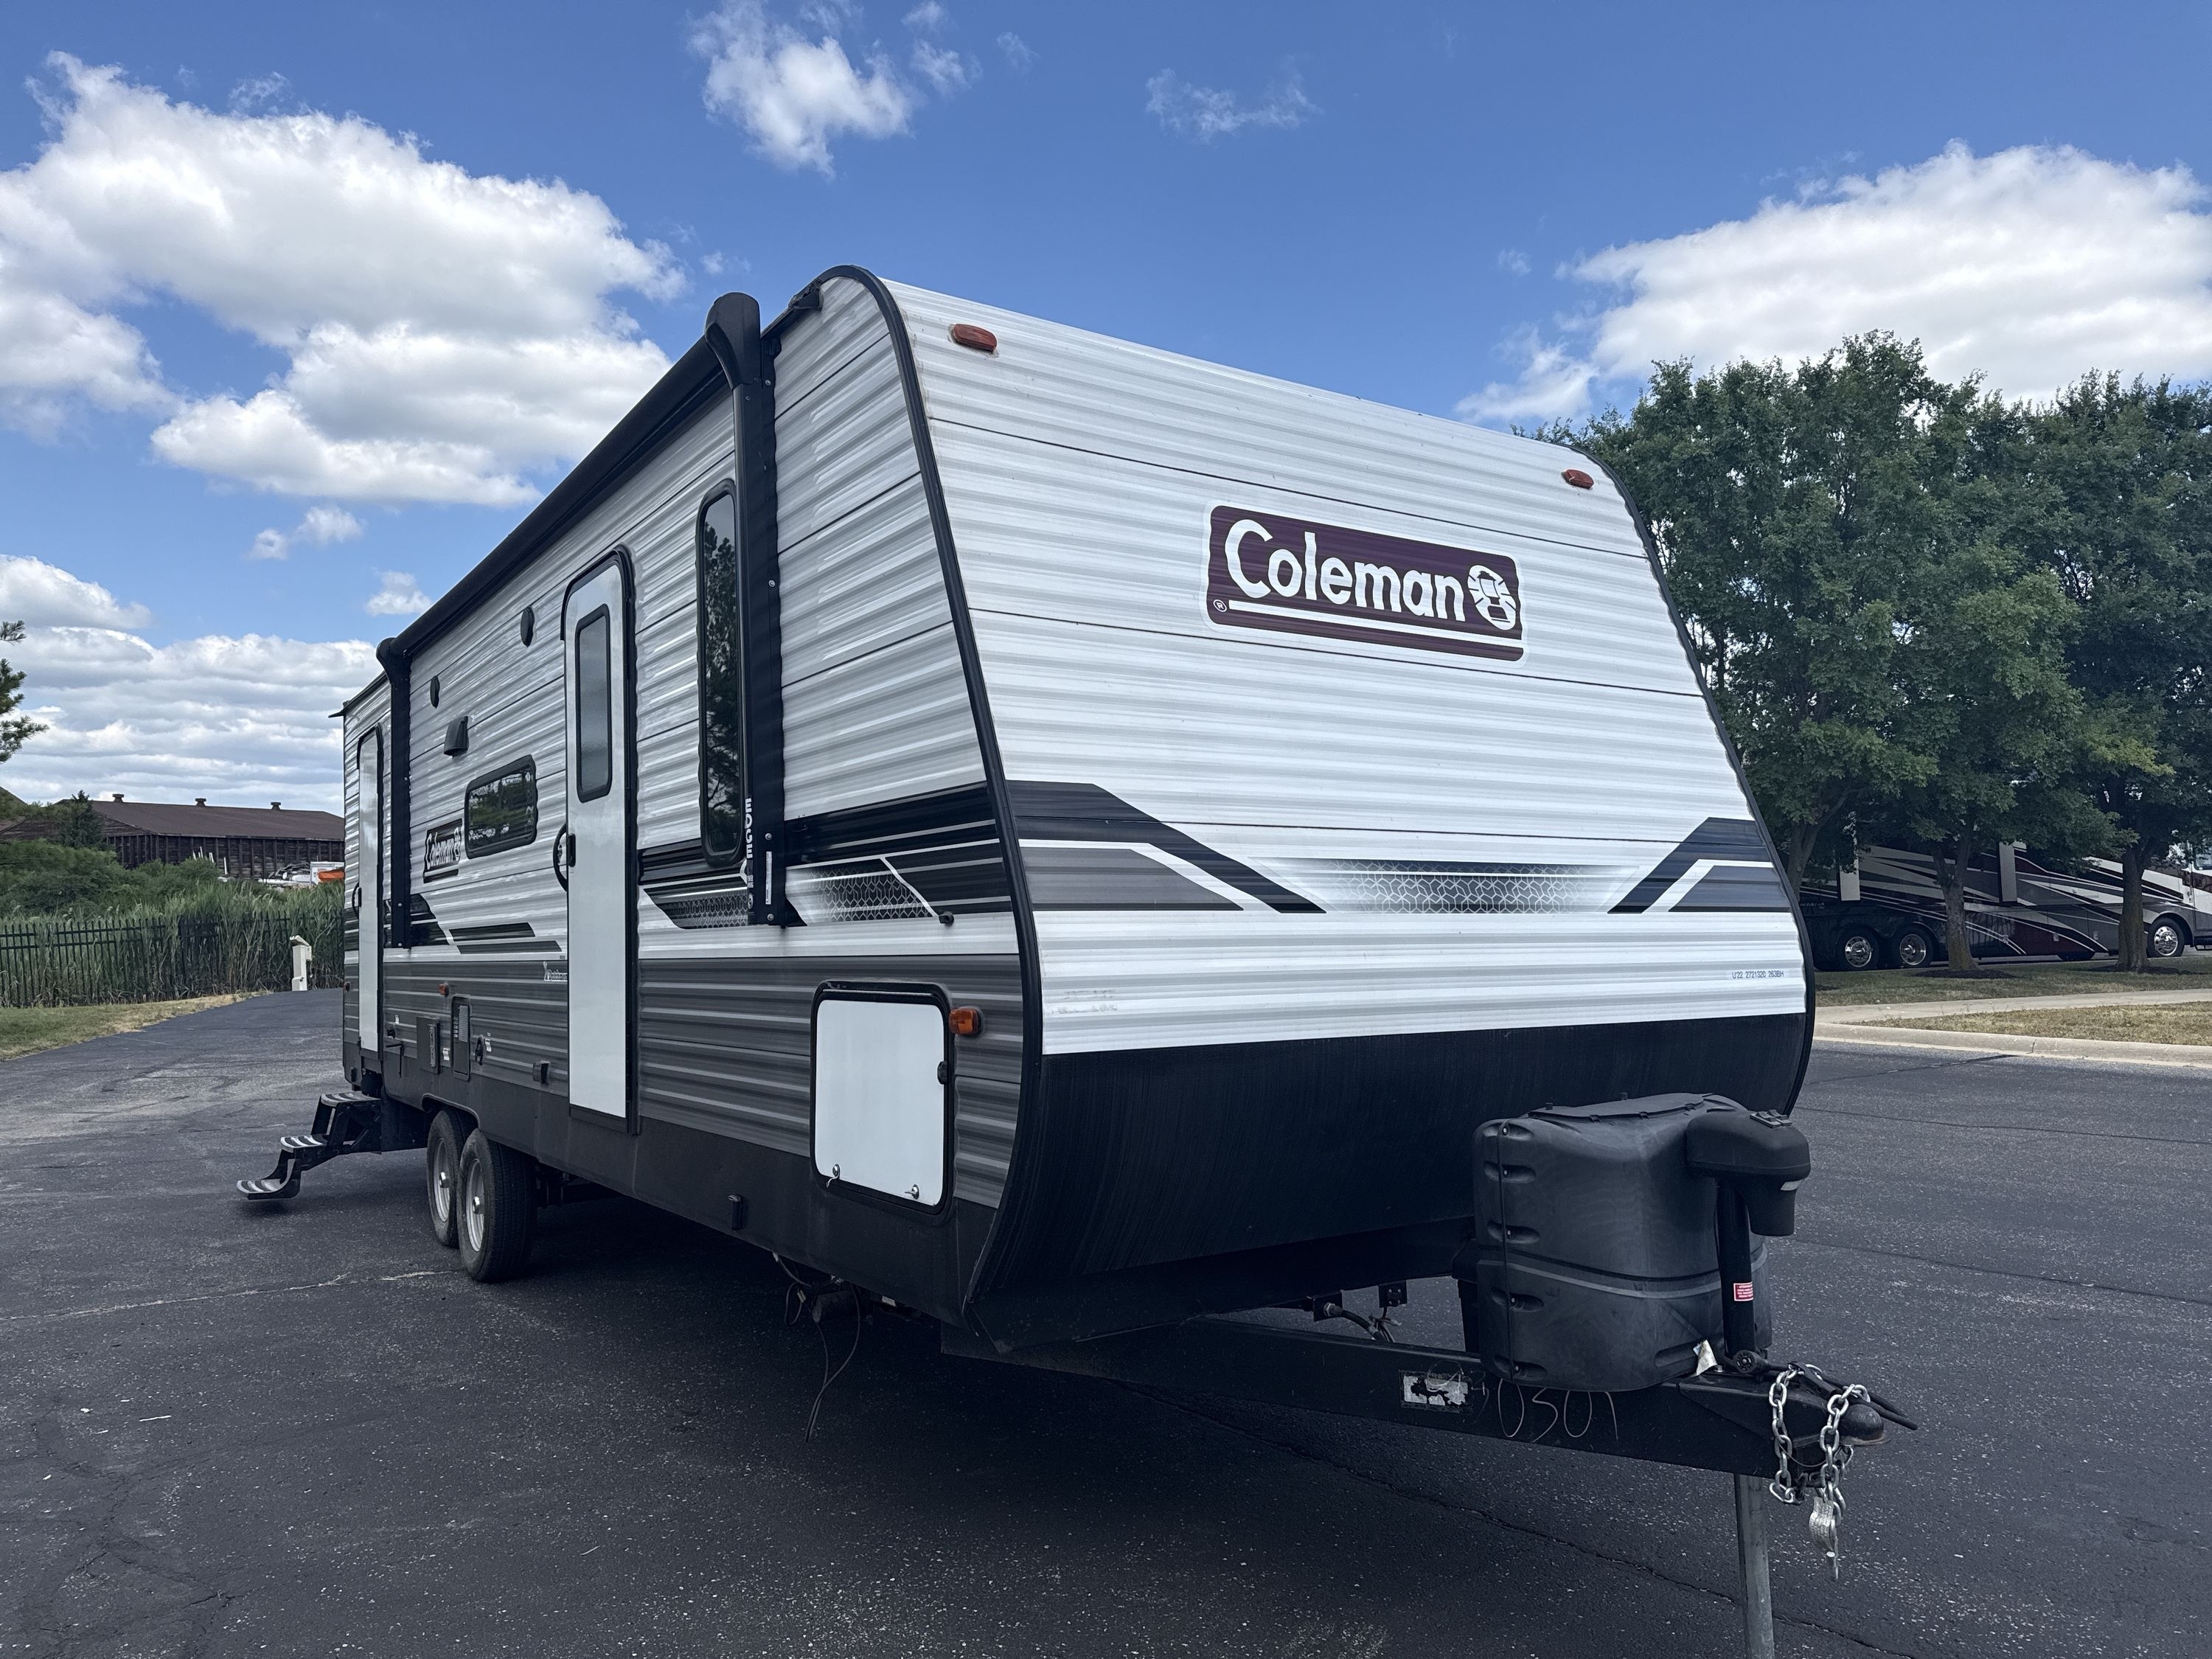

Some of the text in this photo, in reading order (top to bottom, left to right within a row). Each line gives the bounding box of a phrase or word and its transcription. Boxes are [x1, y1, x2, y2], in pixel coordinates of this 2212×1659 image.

[1224, 518, 1466, 622] Coleman
[425, 831, 454, 871] Coleman
[745, 798, 753, 859] EDGE
